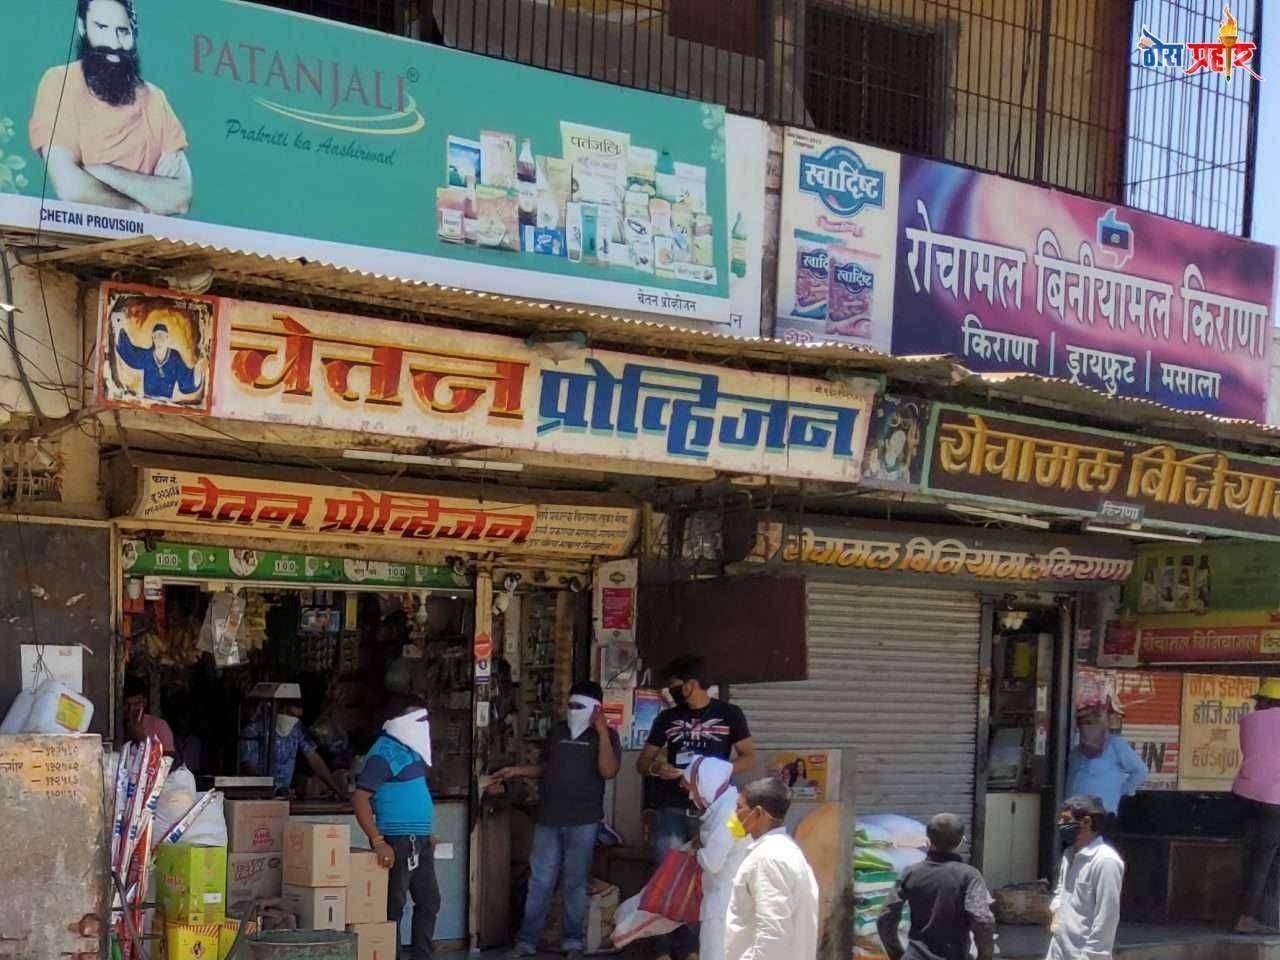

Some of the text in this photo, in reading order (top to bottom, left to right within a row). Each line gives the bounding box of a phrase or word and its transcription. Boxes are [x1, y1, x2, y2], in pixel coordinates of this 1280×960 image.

[192, 33, 406, 113] PATANJALI
[293, 134, 312, 151] ka
[39, 207, 144, 234] CHETAN PROVISION
[637, 289, 660, 307] चेतन
[905, 200, 1269, 359] रोचामल बिनीयामल किराणा
[229, 312, 531, 420] चेतन
[961, 314, 1039, 368] किराणा
[1160, 361, 1222, 400] मसाला
[176, 477, 313, 530] चेतन
